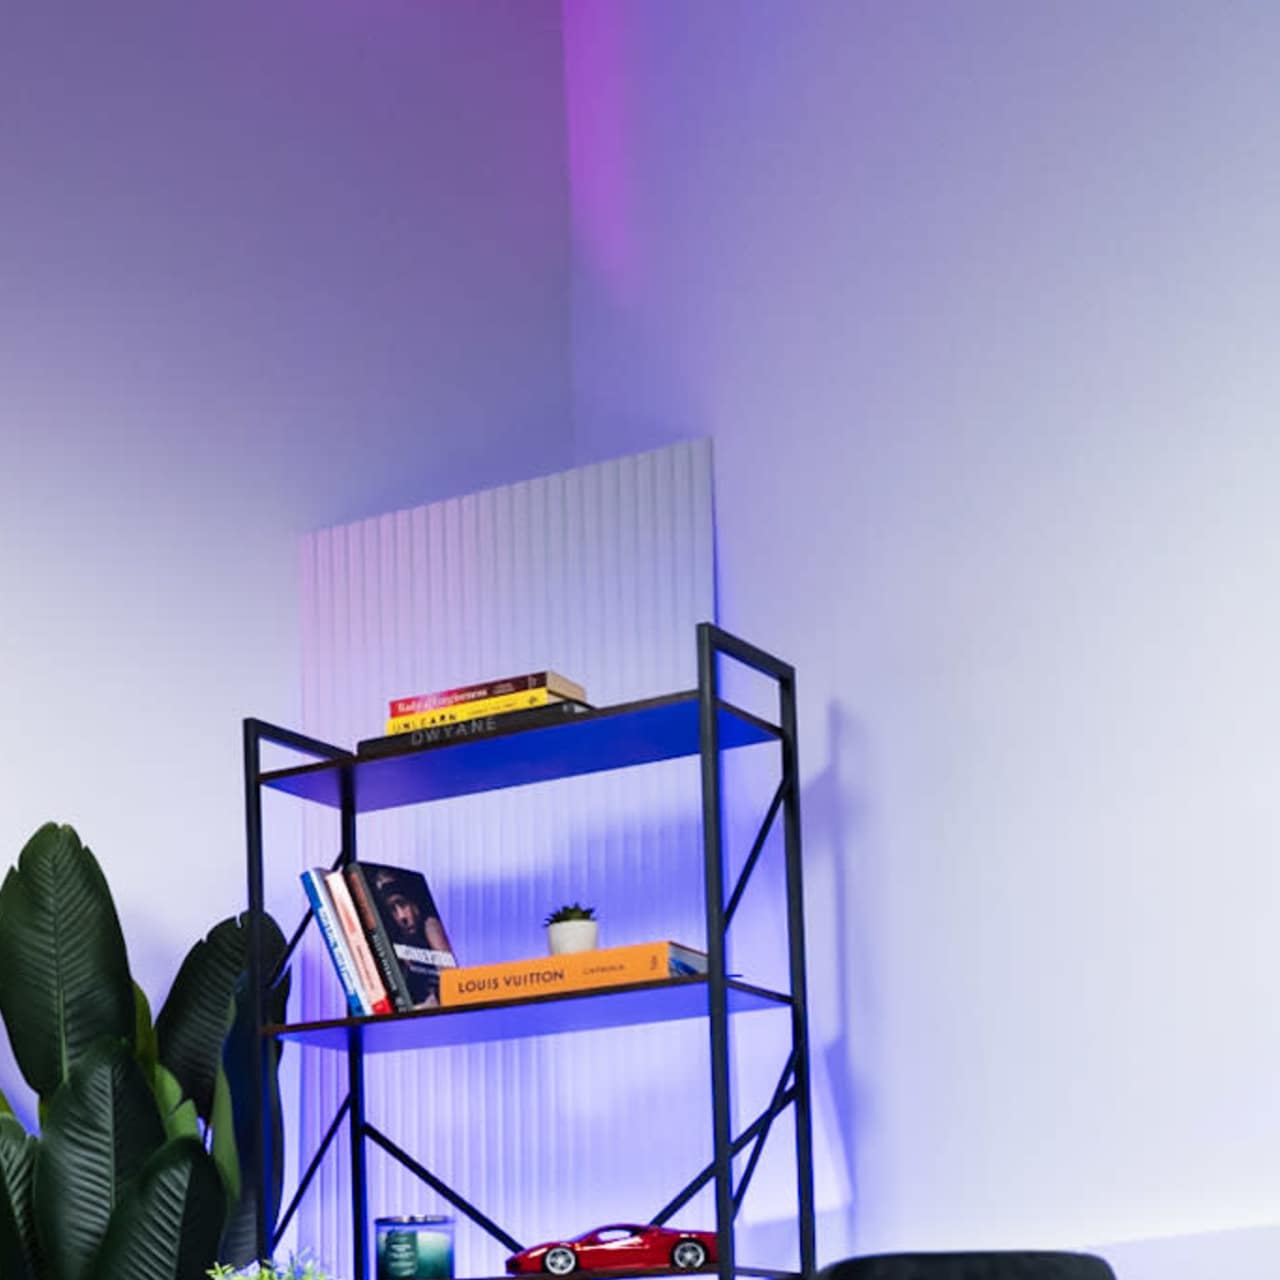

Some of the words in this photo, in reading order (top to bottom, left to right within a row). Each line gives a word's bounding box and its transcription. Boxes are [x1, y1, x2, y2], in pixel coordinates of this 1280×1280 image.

[411, 718, 497, 746] DWYANE
[458, 976, 498, 993] LOUIS
[504, 970, 564, 988] VUITTON
